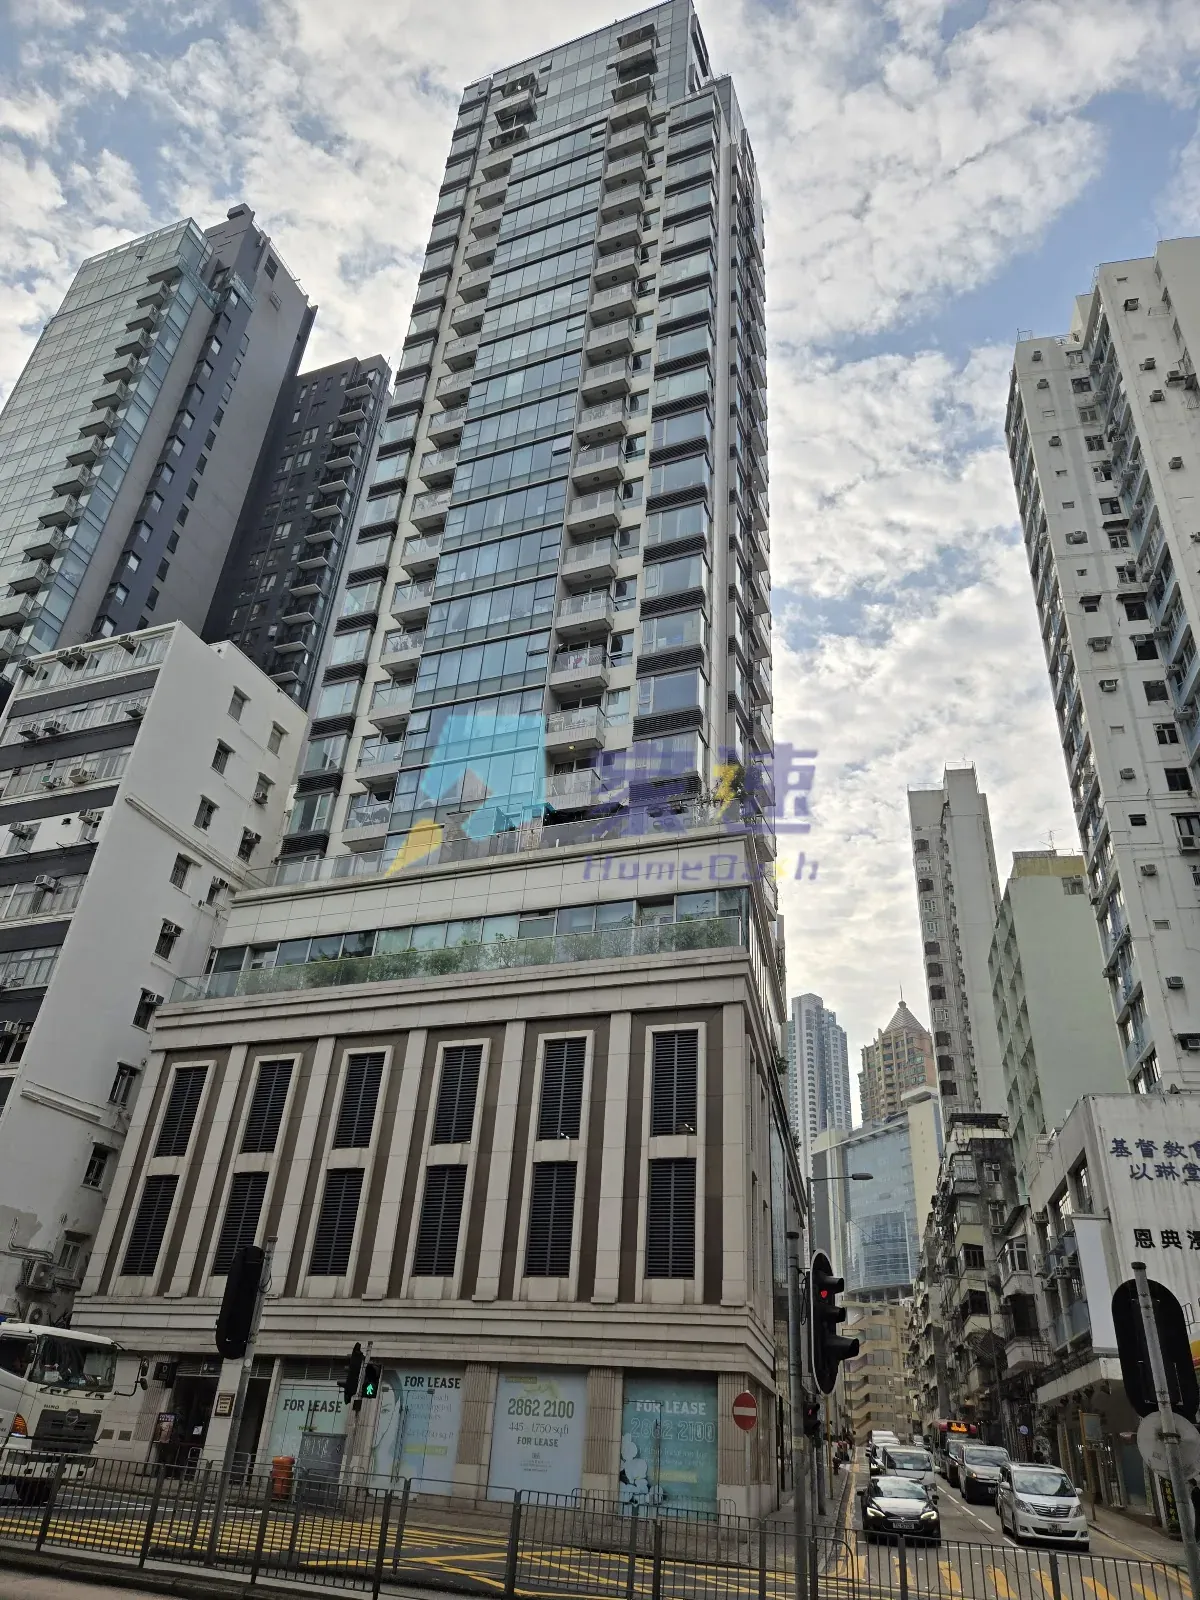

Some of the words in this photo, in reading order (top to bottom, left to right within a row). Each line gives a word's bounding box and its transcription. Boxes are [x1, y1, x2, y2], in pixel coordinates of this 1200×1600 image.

[1129, 1162, 1200, 1182] 以琳堂
[404, 1376, 424, 1387] FOR
[428, 1377, 461, 1389] LEASE
[283, 1399, 303, 1411] FOR
[308, 1401, 342, 1413] LEASE
[507, 1398, 540, 1416] 2862
[543, 1400, 574, 1418] 2100
[636, 1400, 660, 1412] FOR
[665, 1402, 706, 1415] LEASE
[509, 1422, 524, 1432] 445
[630, 1418, 673, 1440] 2862
[678, 1421, 715, 1442] 2100
[517, 1437, 532, 1446] FOR
[534, 1438, 559, 1448] LEASE
